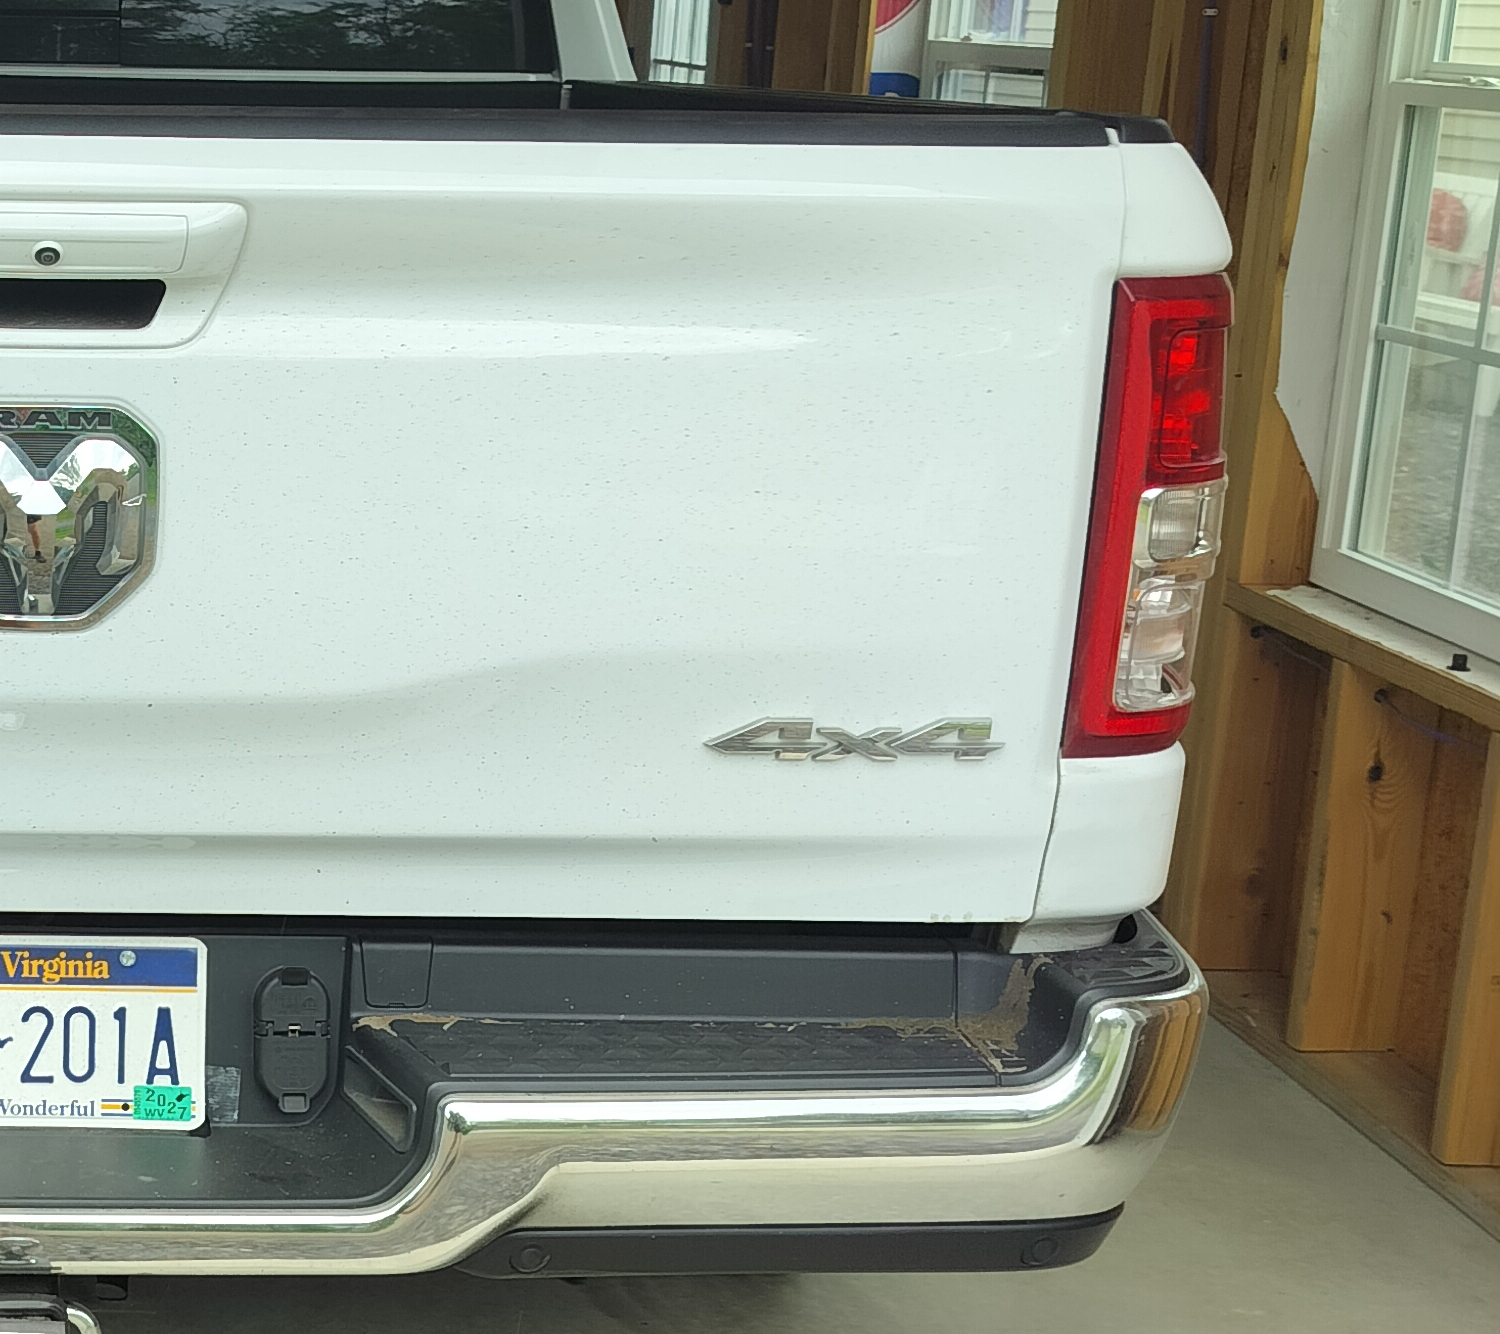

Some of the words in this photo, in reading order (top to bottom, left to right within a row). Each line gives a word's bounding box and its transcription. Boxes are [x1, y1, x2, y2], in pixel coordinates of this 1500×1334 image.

[703, 716, 1007, 762] 4x4
[2, 950, 111, 984] Virginia
[19, 1006, 180, 1086] 201A
[143, 1107, 166, 1118] WV
